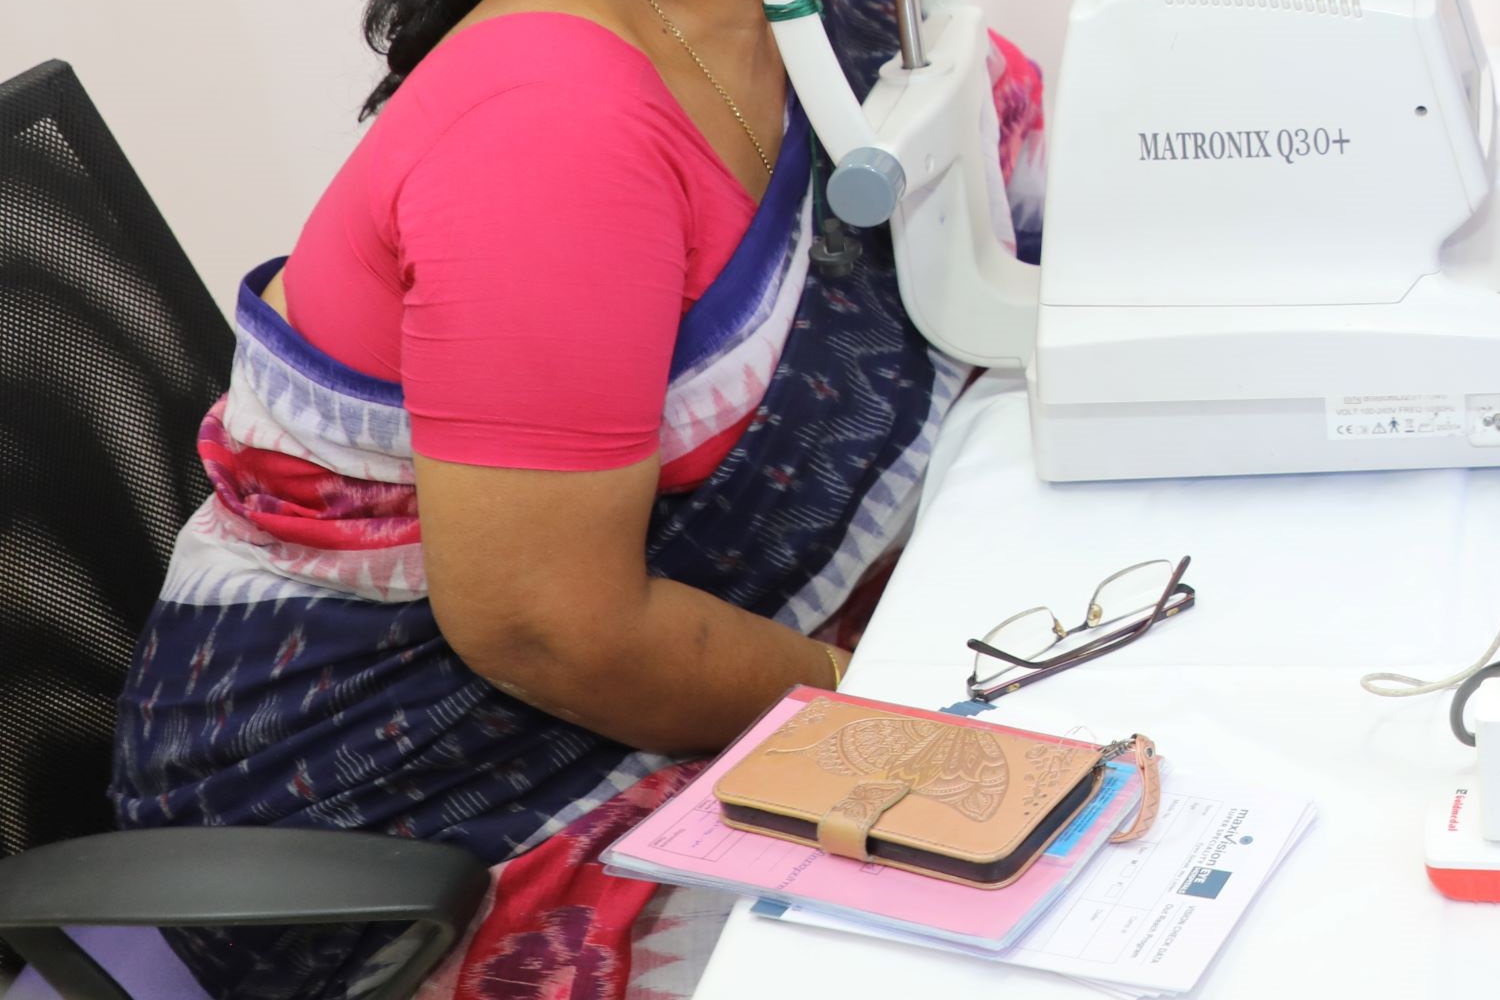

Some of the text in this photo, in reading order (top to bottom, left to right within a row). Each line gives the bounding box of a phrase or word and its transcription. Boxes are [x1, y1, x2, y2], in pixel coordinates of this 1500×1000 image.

[1137, 127, 1351, 163] MATRONIX Q30+
[1205, 809, 1250, 866] maxivision
[1193, 868, 1213, 884] EYE
